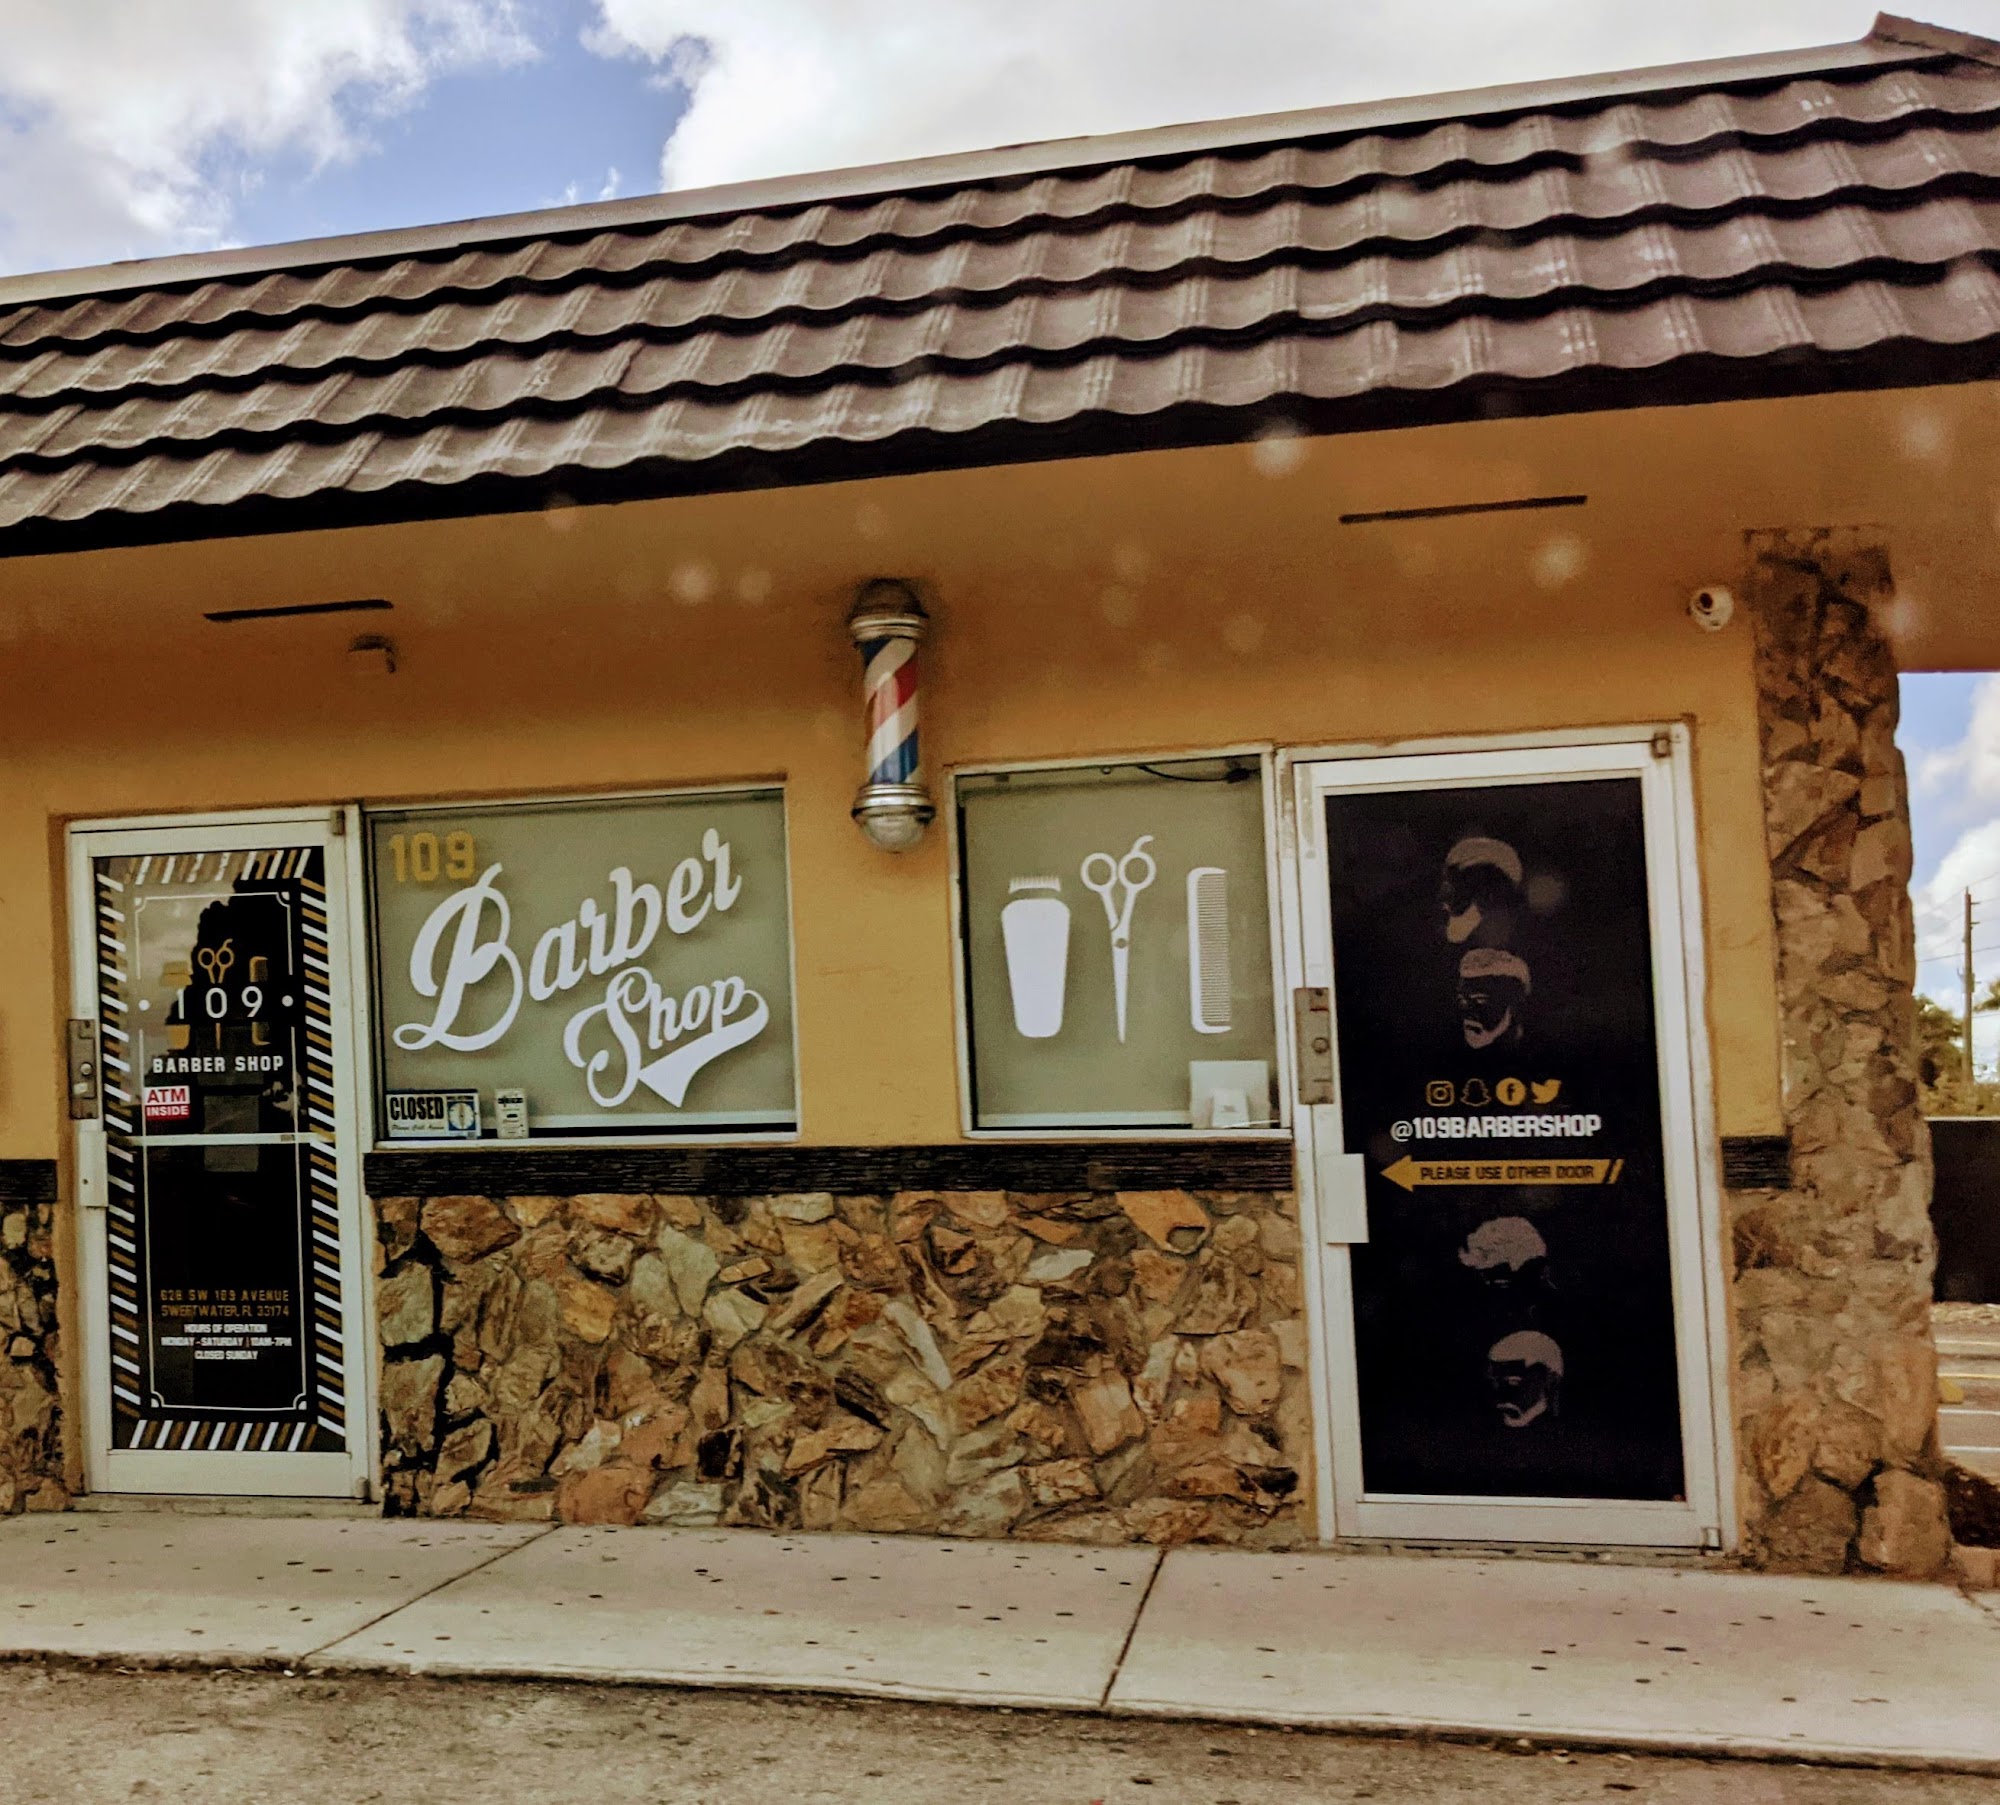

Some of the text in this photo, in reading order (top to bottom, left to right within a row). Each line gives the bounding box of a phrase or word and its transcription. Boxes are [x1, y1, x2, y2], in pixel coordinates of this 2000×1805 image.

[390, 831, 477, 882] 109
[393, 828, 742, 1052] Barber
[176, 986, 264, 1019] 109
[564, 966, 769, 1108] Shop
[152, 1055, 284, 1073] BARBER SHOP
[147, 1087, 187, 1104] ATM
[146, 1104, 190, 1117] INSIDE
[390, 1096, 444, 1120] CLOSED
[1391, 1114, 1601, 1142] @109BARBERSHOP
[1421, 1165, 1595, 1180] PLEASE USE OTHER DOOR
[188, 1289, 208, 1301] SW
[241, 1289, 289, 1301] AVENUE
[184, 1323, 268, 1333] HOURS OF OPERATION
[161, 1337, 195, 1346] MONDAY
[194, 1350, 259, 1360] CLOSED SUNDAY
